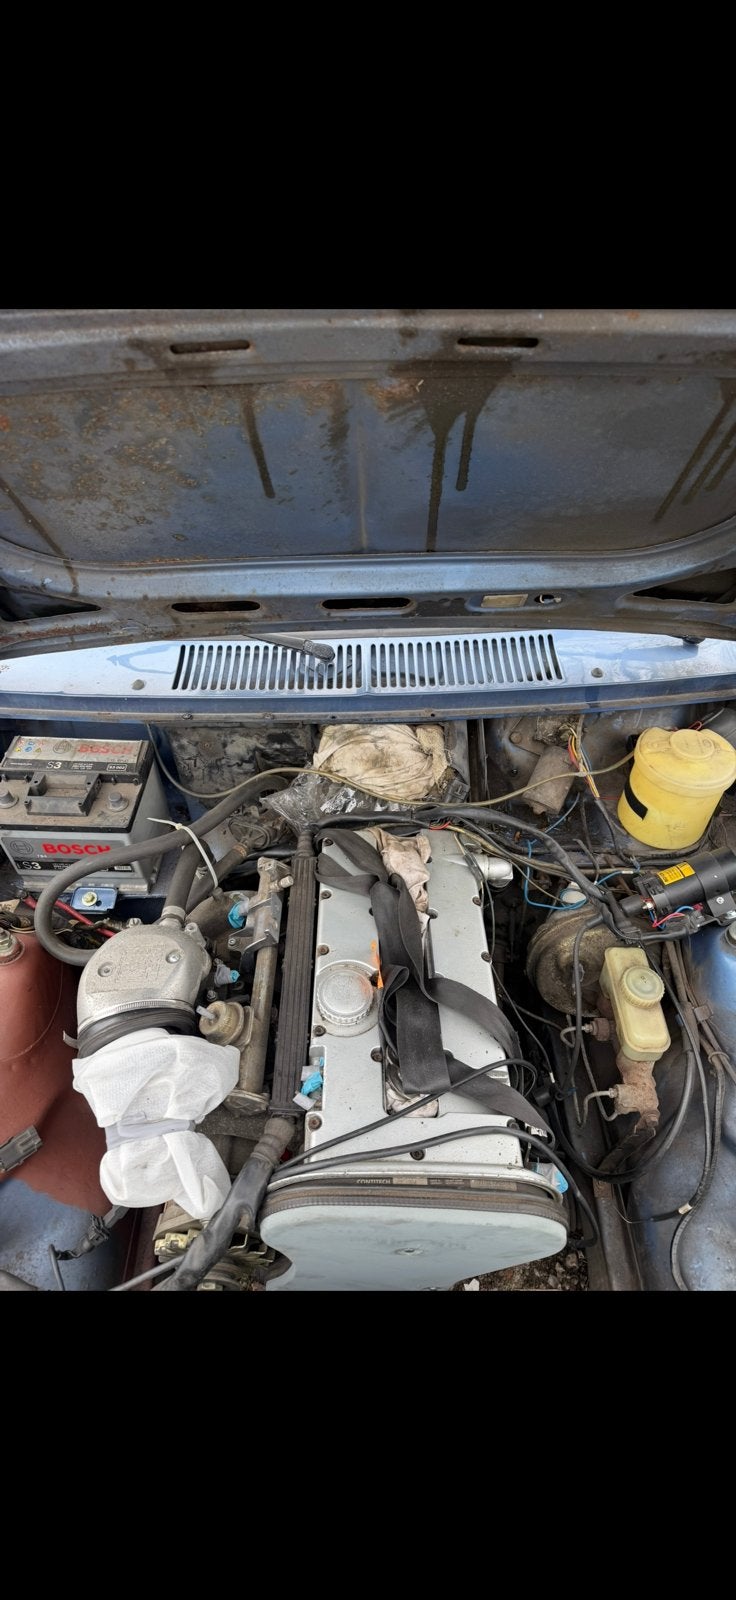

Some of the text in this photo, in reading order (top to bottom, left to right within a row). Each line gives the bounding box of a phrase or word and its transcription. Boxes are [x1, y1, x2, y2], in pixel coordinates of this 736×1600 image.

[78, 743, 133, 754] BOSCH
[46, 761, 62, 769] S3
[42, 843, 111, 855] BOSCH
[22, 861, 41, 870] S3
